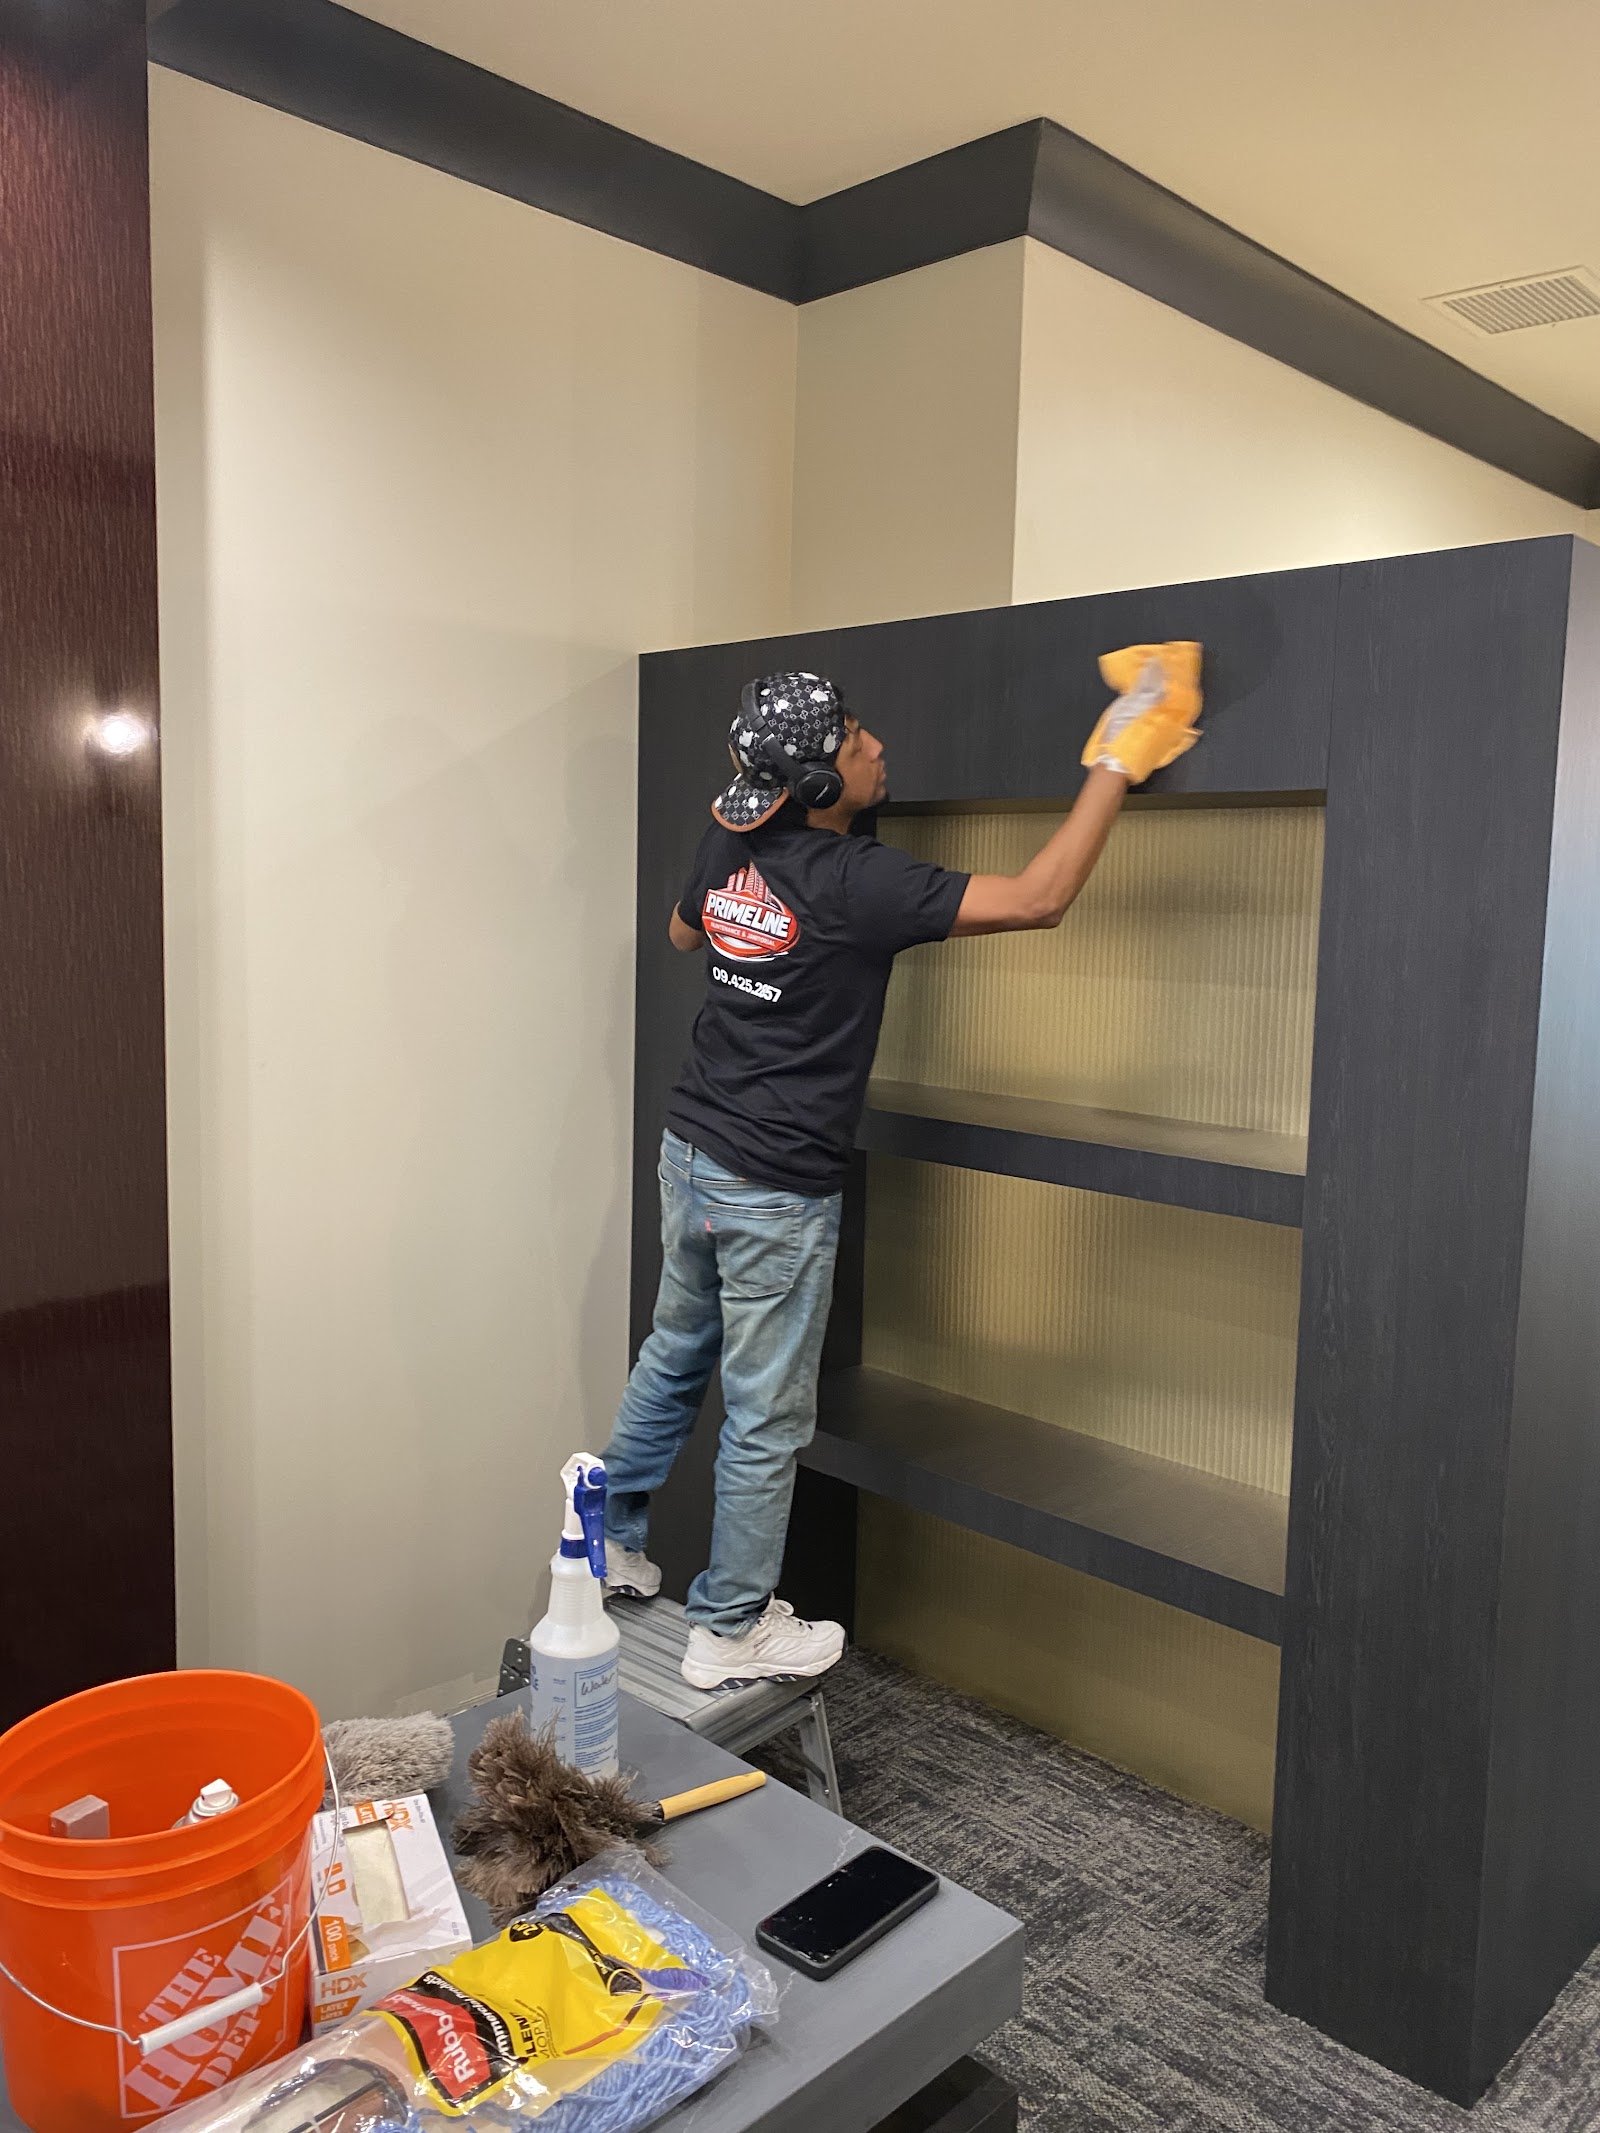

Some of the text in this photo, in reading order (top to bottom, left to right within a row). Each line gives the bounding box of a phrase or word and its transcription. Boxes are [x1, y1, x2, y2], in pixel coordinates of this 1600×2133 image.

[705, 893, 792, 938] PRIMELINE
[325, 1920, 342, 1963] 100 pack
[123, 1894, 290, 2109] HOME
[138, 1947, 222, 2025] THE
[321, 1971, 368, 1999] HDX
[321, 2000, 349, 2013] LATEX
[509, 2011, 538, 2058] LEN
